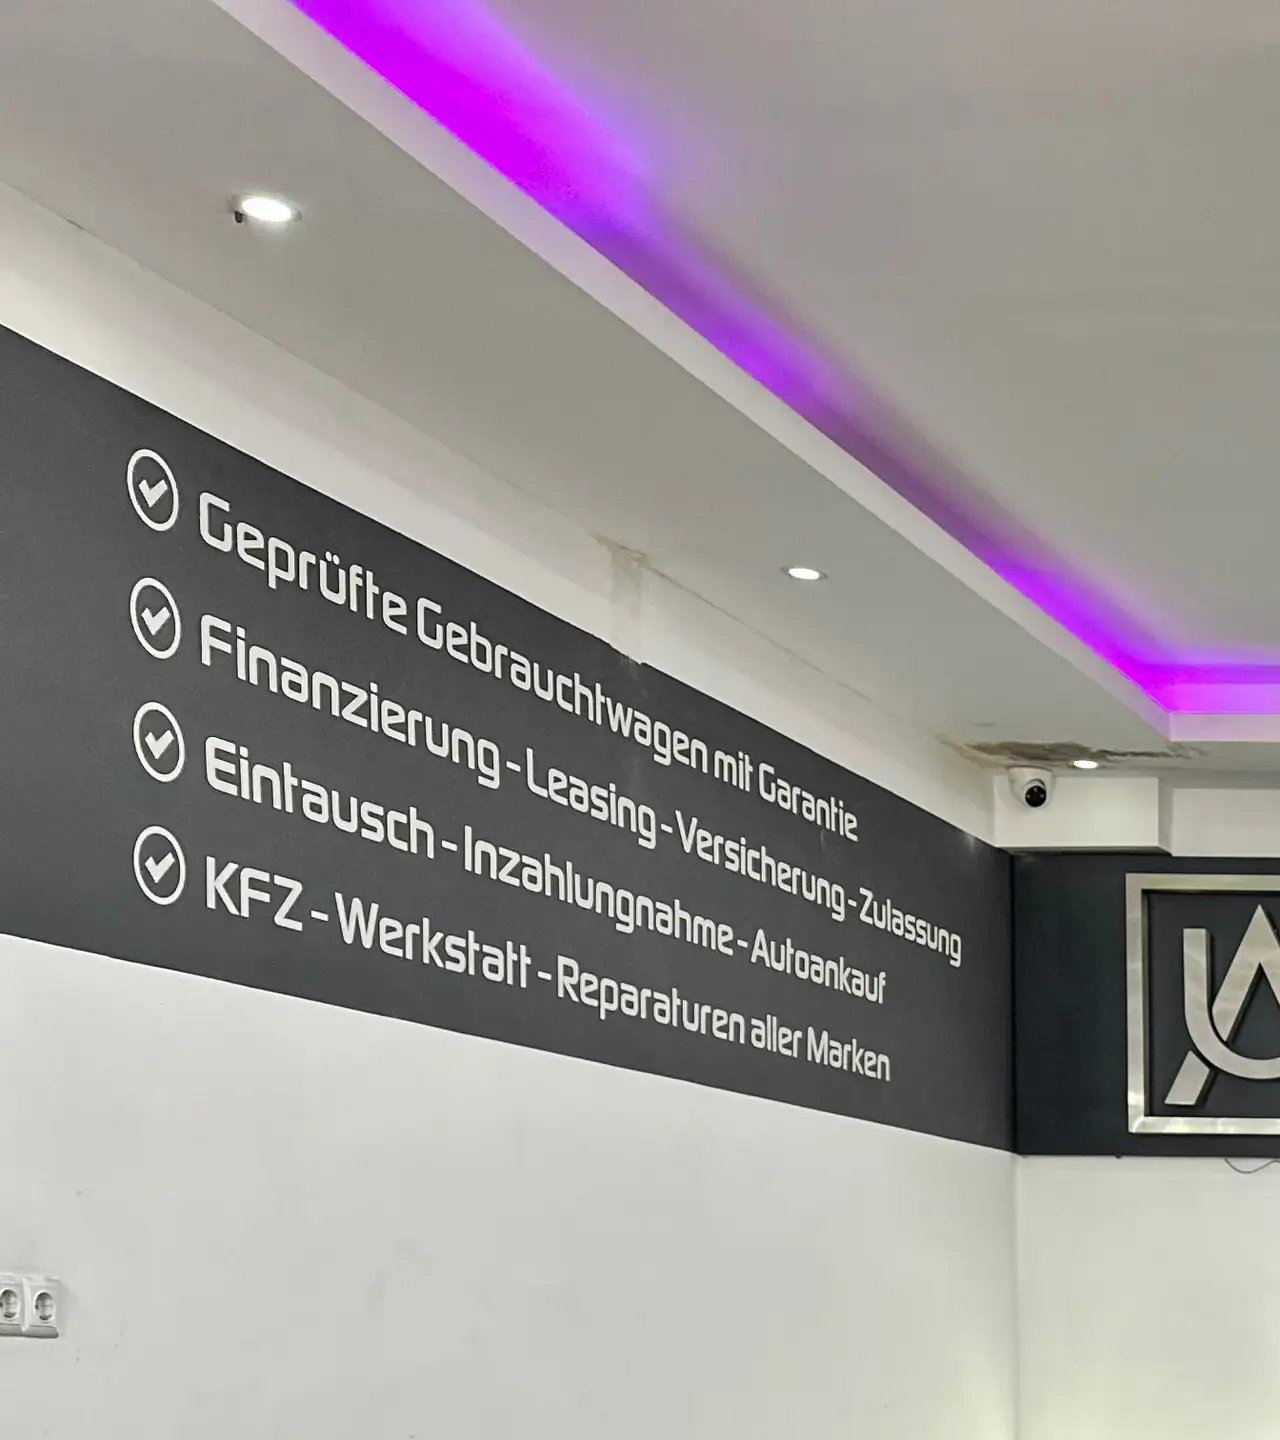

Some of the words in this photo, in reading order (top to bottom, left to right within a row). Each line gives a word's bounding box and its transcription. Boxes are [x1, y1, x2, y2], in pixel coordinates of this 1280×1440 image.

[199, 491, 407, 635] Geprüfte
[417, 596, 708, 773] Gebrauchtwagen
[714, 751, 753, 792] mit
[758, 763, 859, 842] Garantie
[751, 1014, 802, 1058] aller
[807, 1027, 890, 1082] Marken
